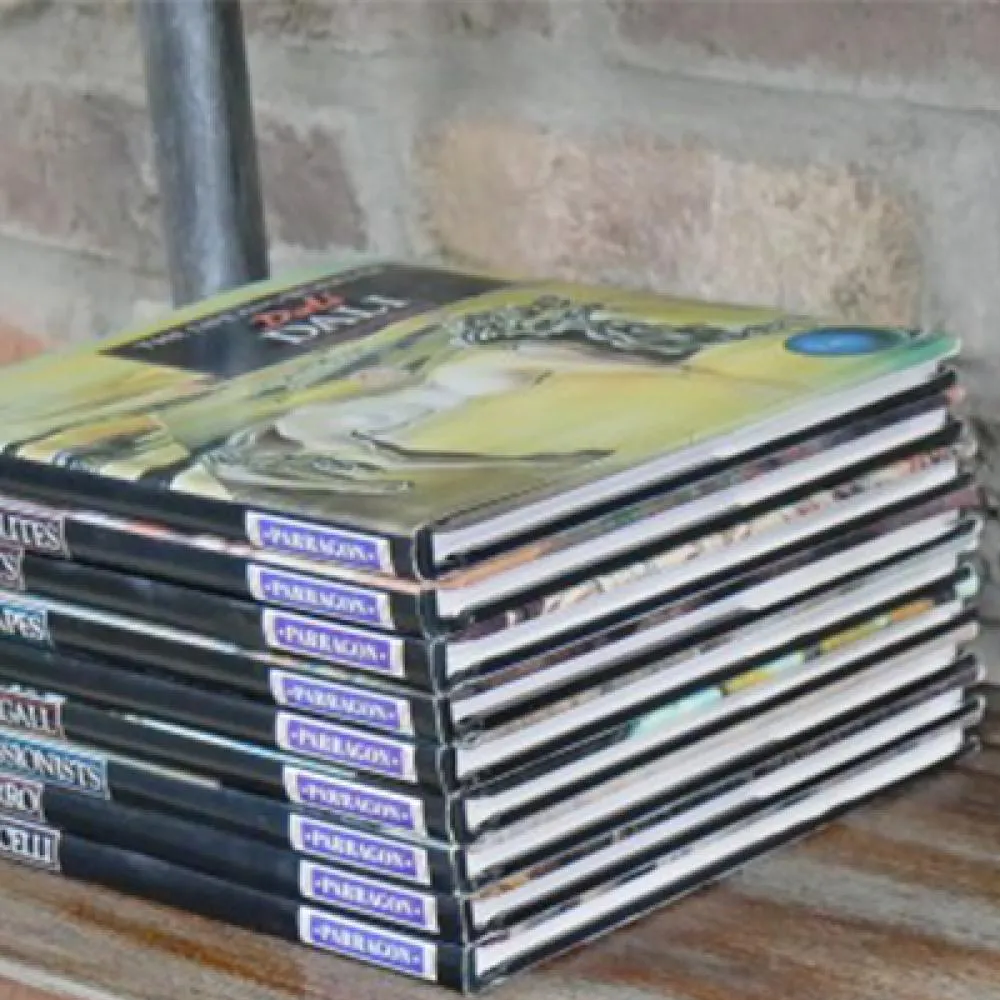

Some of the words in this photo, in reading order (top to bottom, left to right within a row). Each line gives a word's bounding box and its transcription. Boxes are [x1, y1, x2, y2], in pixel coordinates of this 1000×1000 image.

[262, 294, 409, 345] DALI
[286, 626, 378, 657] PARRAGON
[298, 726, 391, 764] PARRAGON
[311, 830, 404, 866] PARRAGON
[320, 878, 414, 913] PARRAGON
[320, 924, 413, 963] PARRAGON
